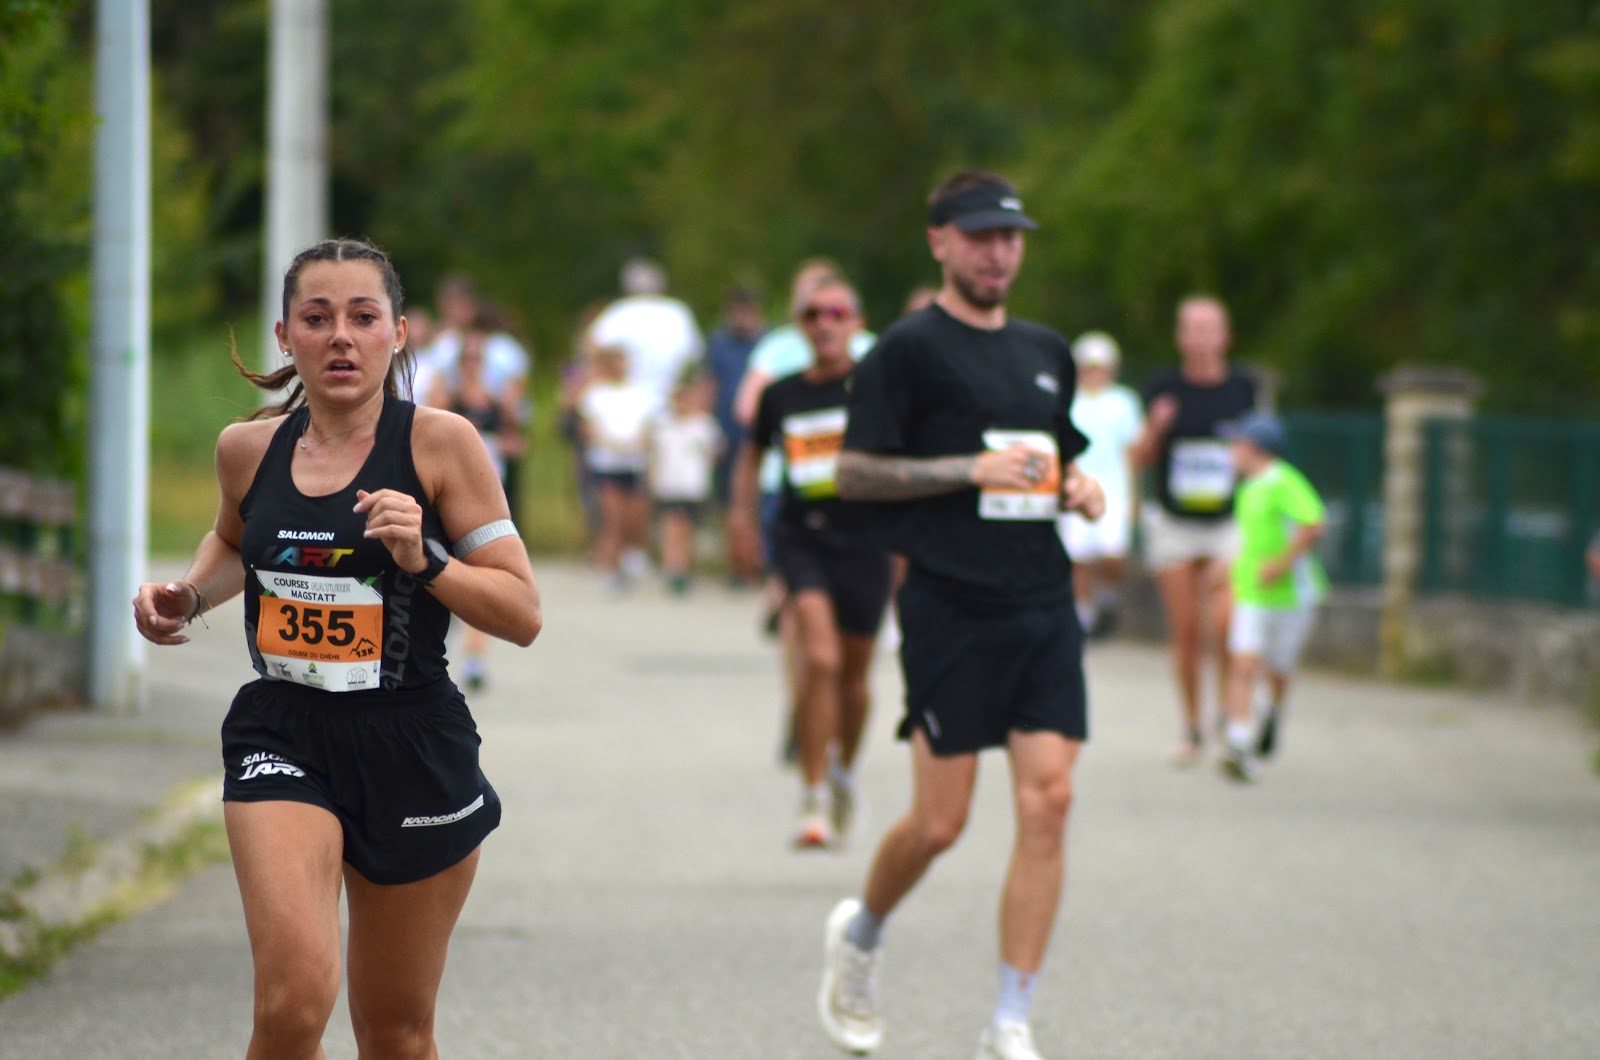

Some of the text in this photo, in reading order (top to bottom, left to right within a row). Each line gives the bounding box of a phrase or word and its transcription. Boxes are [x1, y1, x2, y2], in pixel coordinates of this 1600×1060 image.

[277, 529, 335, 541] SALOMON
[273, 577, 351, 593] COURSES NATURE
[291, 589, 336, 602] MAGSTATT
[278, 604, 356, 647] 355
[309, 651, 319, 659] DU
[355, 647, 375, 659] 13K
